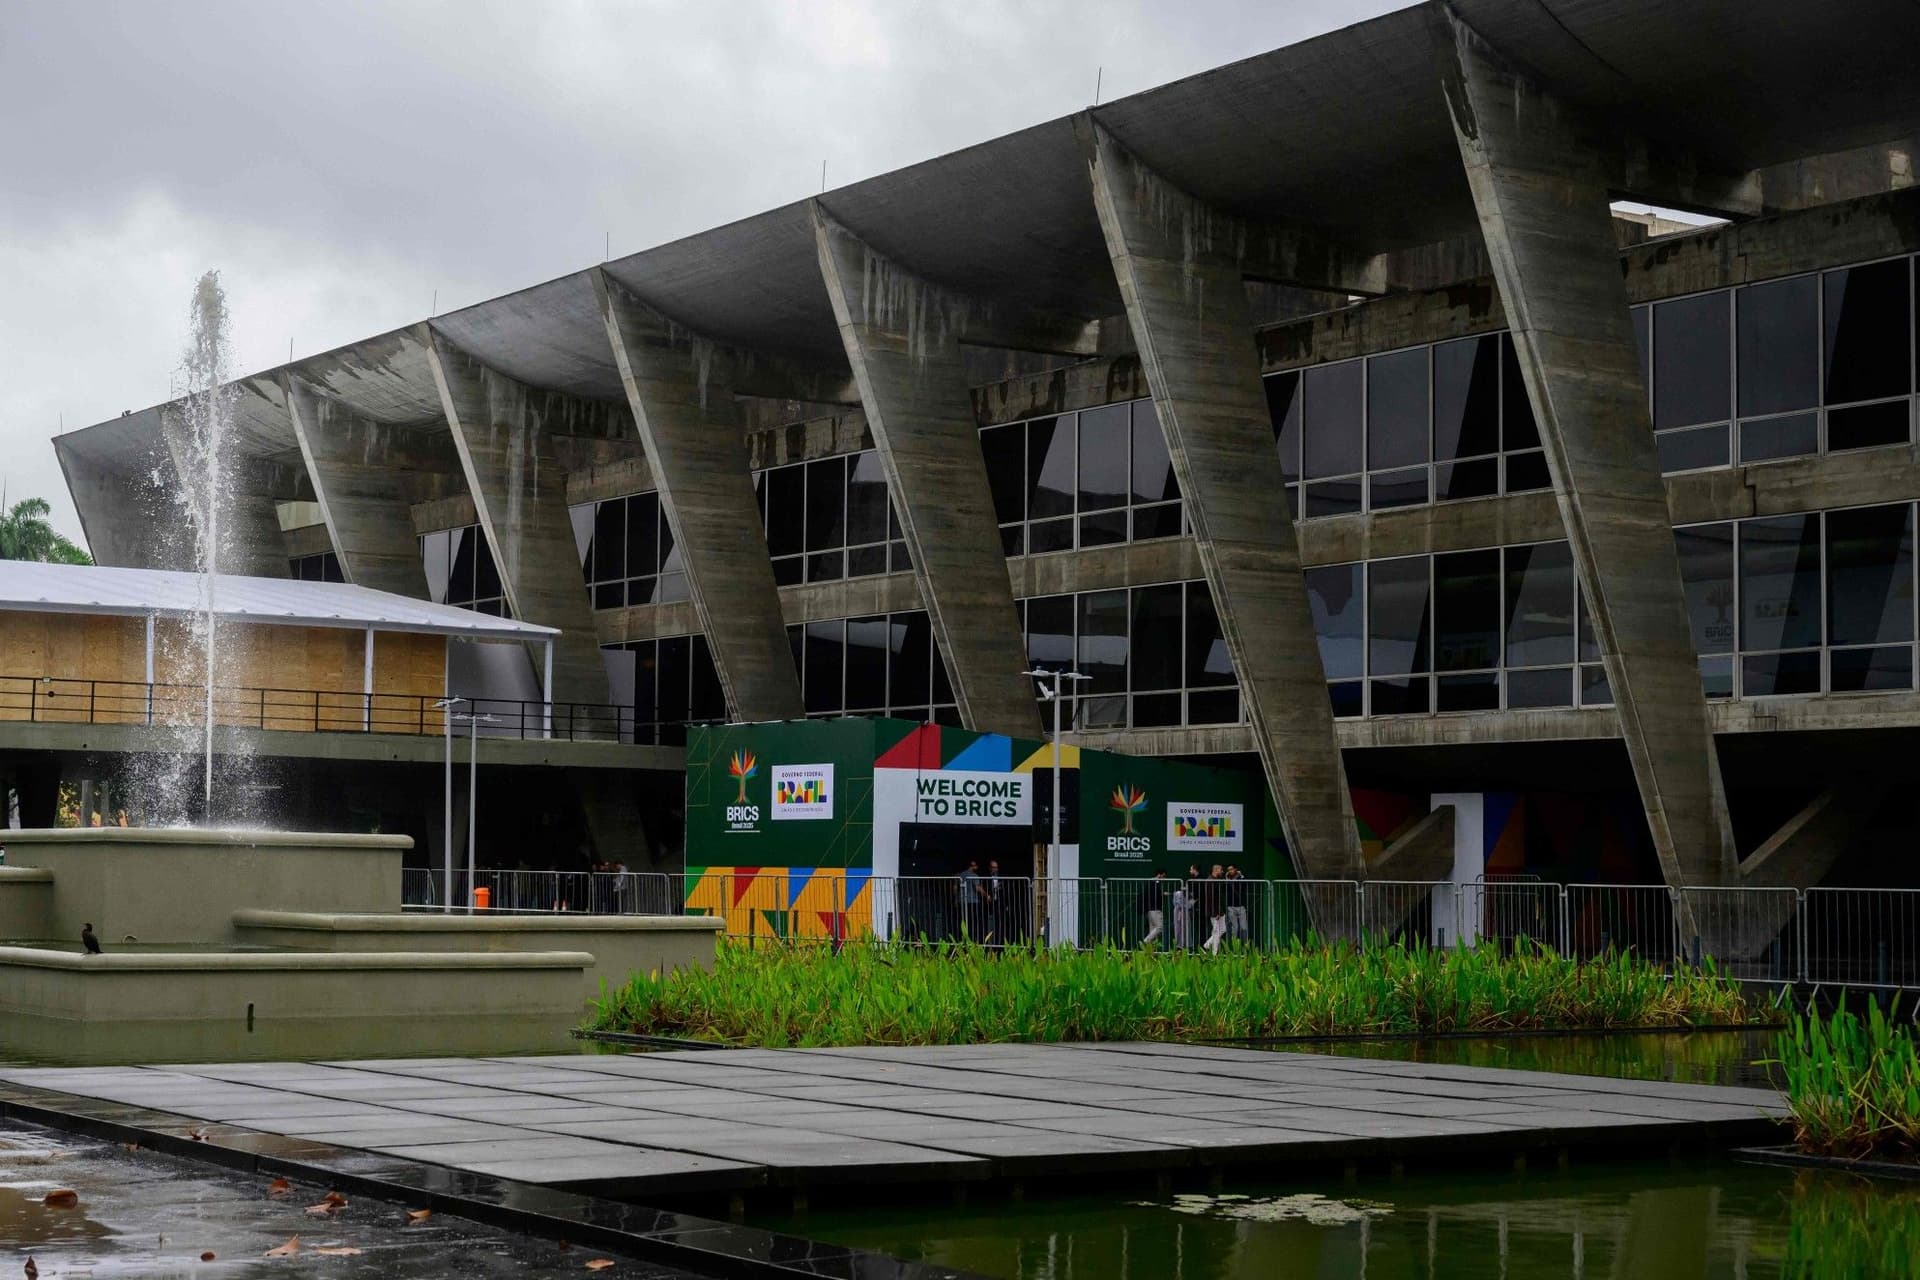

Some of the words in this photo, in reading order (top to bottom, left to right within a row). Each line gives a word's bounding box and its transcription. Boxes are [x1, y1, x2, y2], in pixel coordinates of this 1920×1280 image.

[777, 780, 827, 804] BRASIL
[916, 778, 1022, 798] WELCOME
[726, 806, 759, 821] BRICS
[920, 798, 949, 816] TO
[955, 799, 1017, 817] BRICS
[1174, 817, 1236, 837] BRASIL
[1107, 836, 1151, 851] BRICS
